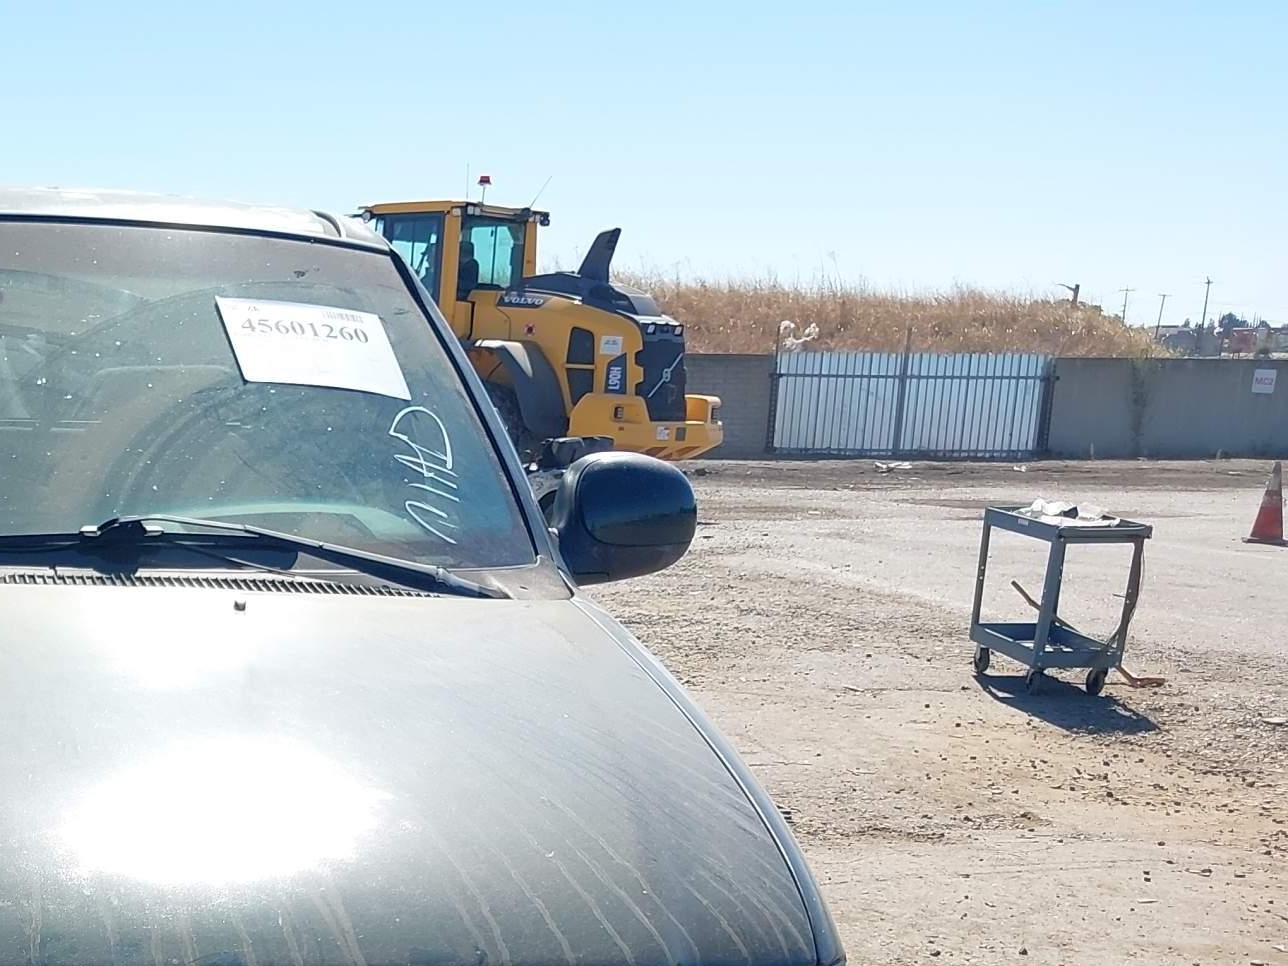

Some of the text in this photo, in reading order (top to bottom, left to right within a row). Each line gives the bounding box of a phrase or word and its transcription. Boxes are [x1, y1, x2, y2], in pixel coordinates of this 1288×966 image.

[504, 295, 544, 306] VOLVO
[241, 317, 369, 344] 45601260
[607, 366, 623, 390] L90H
